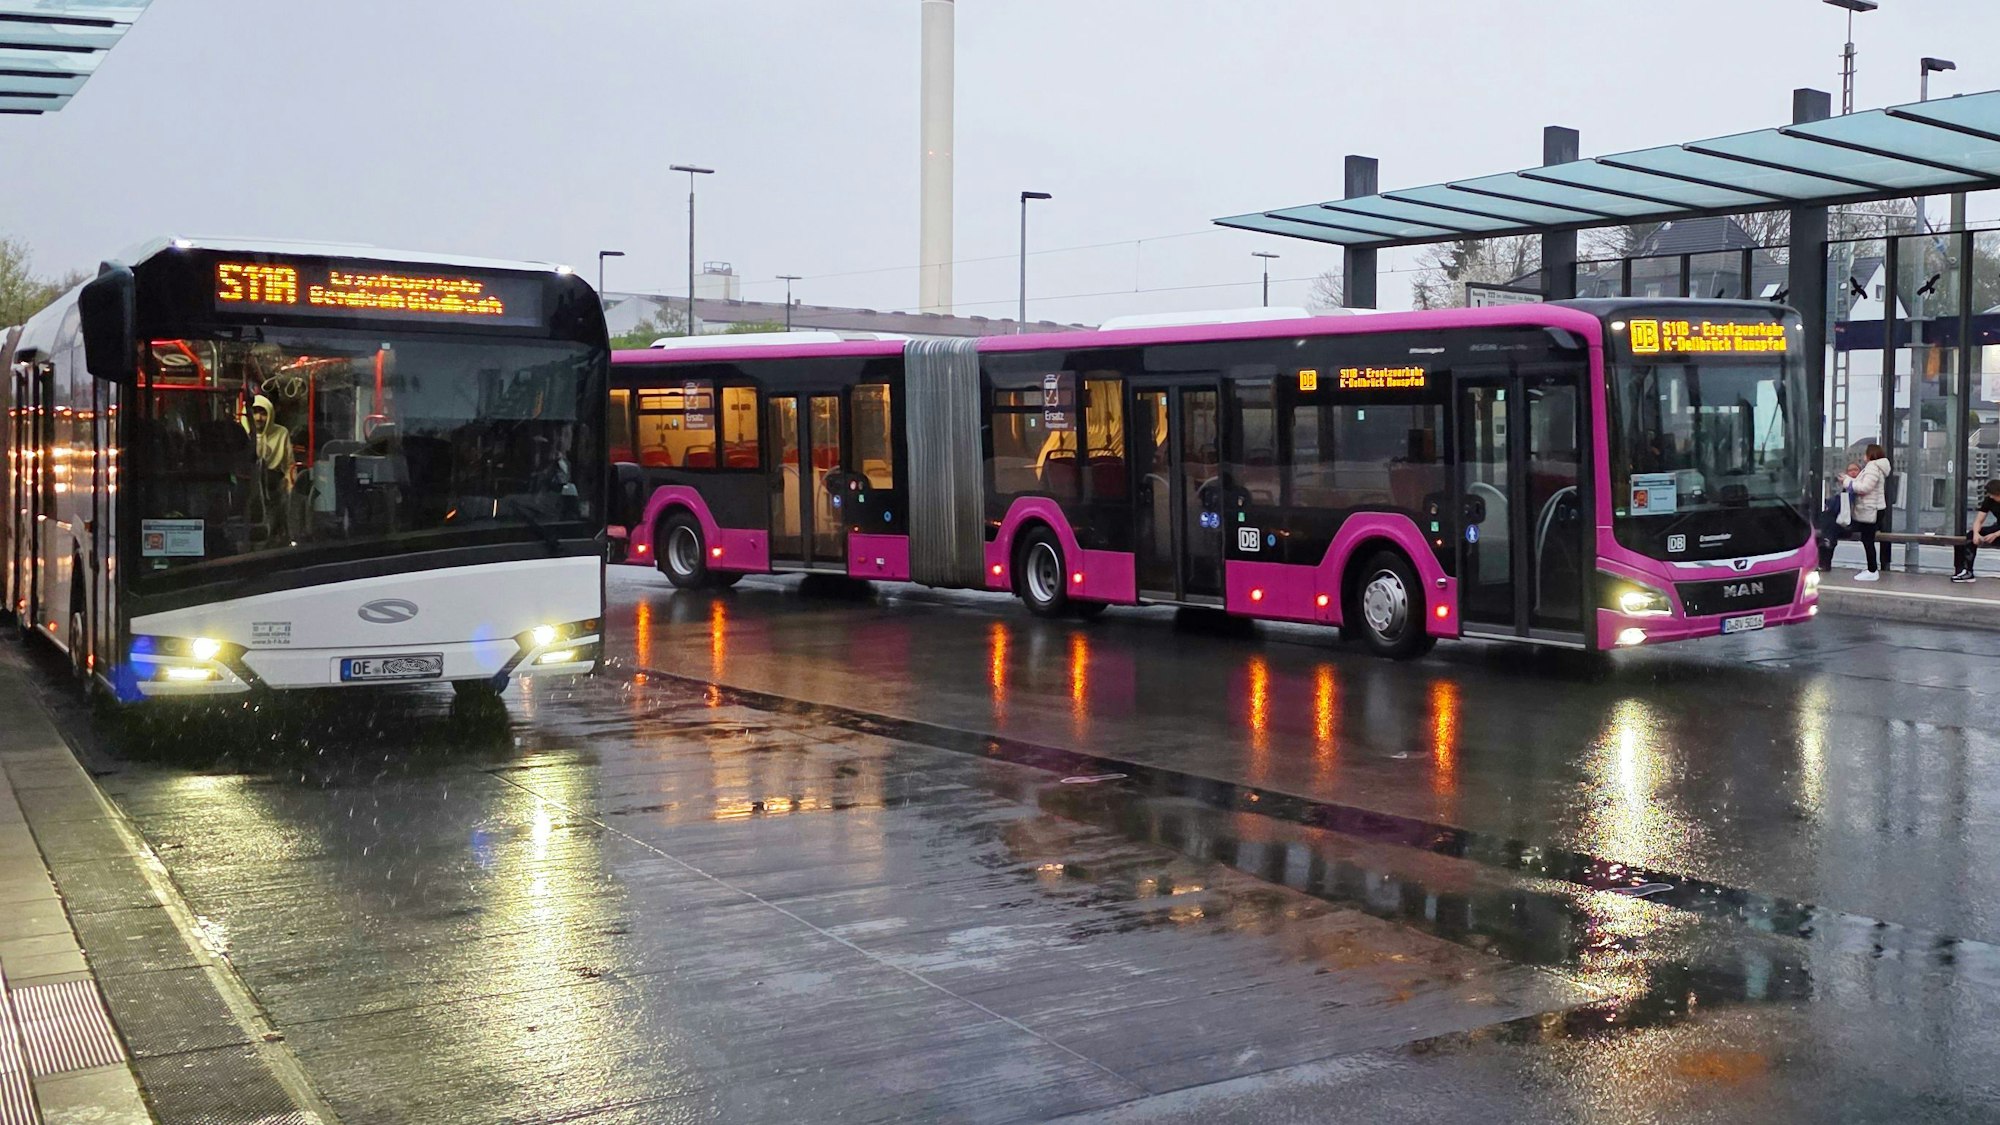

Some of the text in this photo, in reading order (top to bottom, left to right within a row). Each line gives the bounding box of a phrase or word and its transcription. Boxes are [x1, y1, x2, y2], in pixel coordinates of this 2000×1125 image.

[1662, 321, 1689, 336] S11B
[1702, 321, 1785, 337] Ersatzverkehr
[1663, 336, 1732, 352] K-Dellbrück
[1723, 581, 1764, 598] MAN
[352, 661, 371, 675] OE
